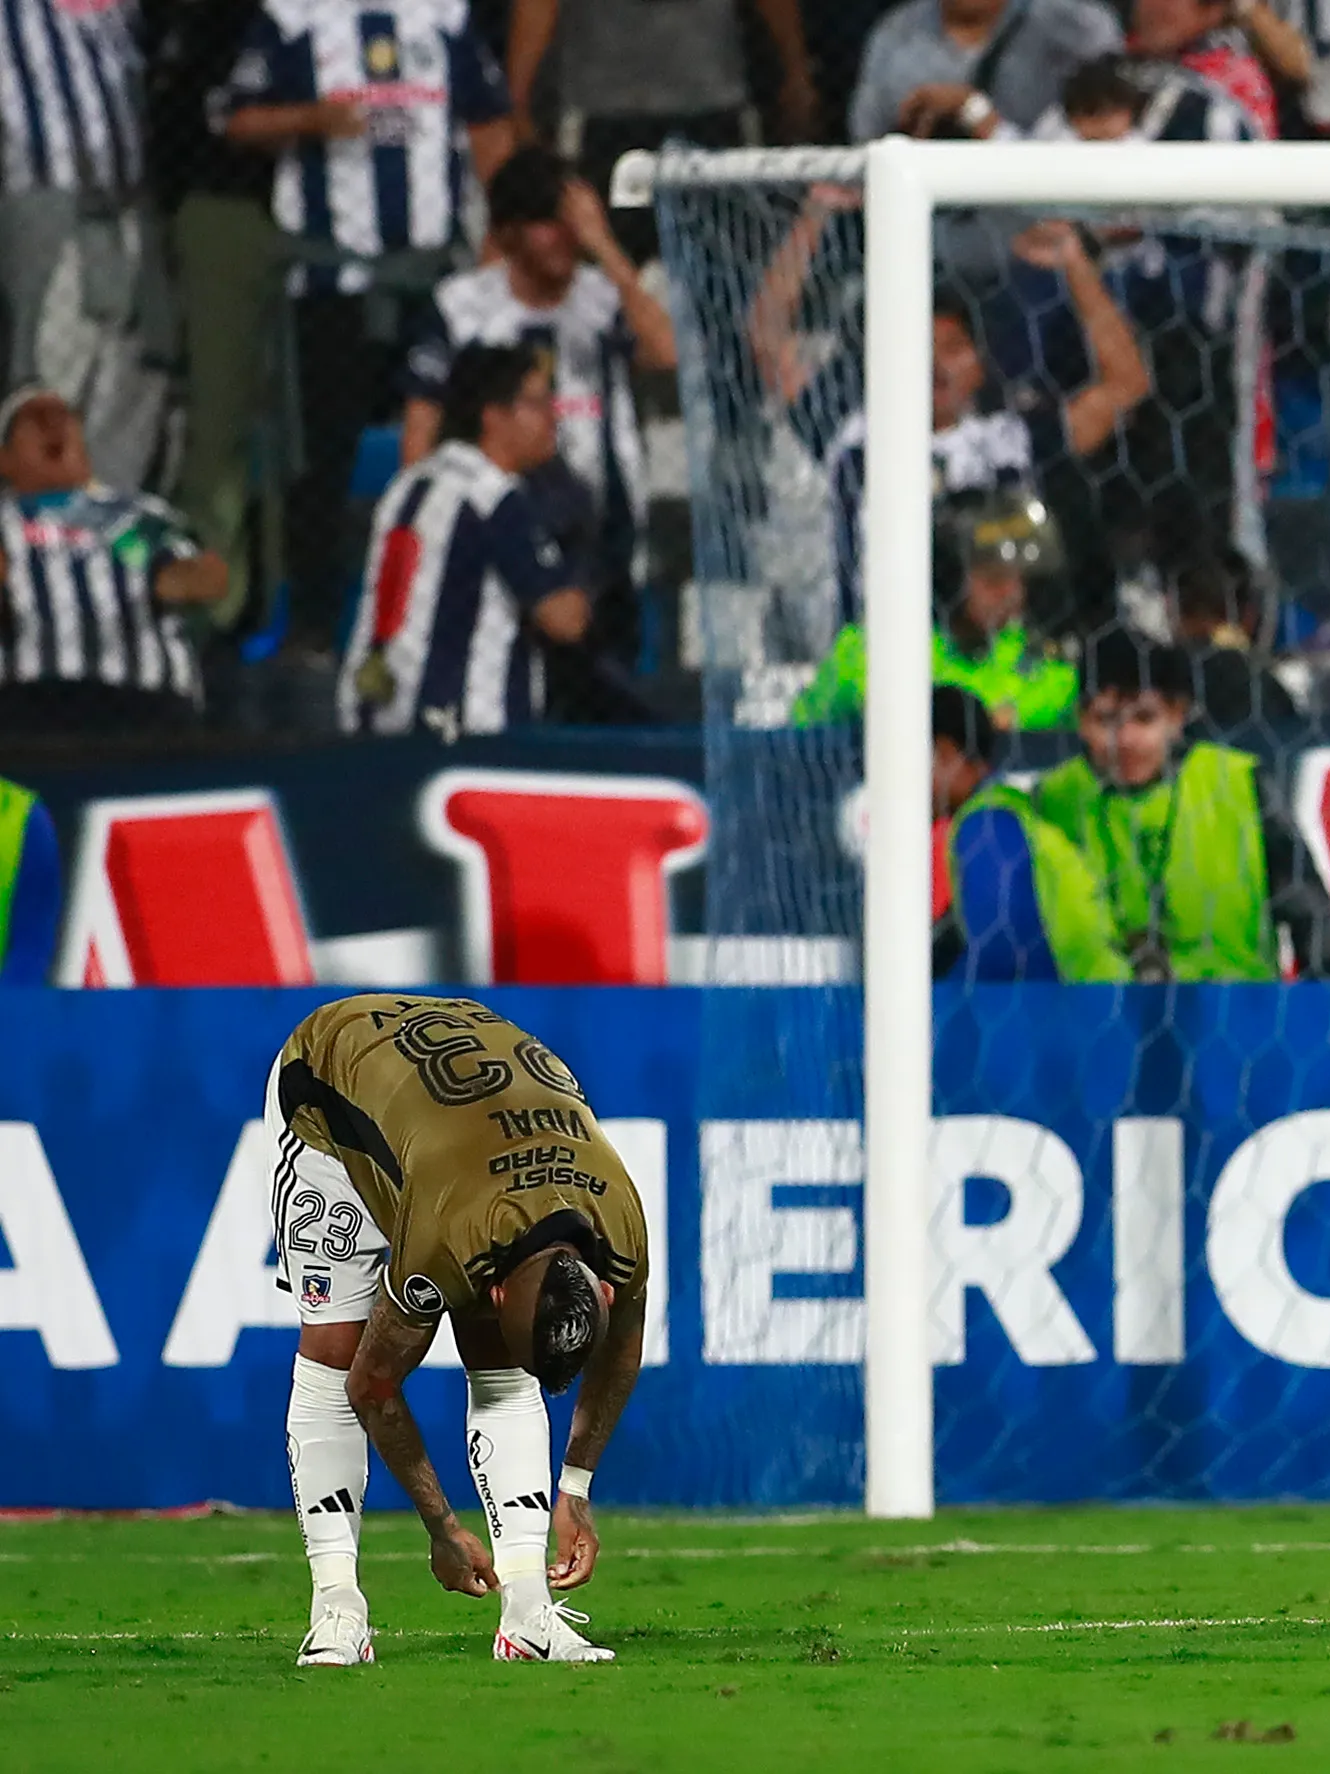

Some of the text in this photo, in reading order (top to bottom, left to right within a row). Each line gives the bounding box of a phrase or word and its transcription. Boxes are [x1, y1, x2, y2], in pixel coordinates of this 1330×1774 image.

[487, 1108, 591, 1142] VIDAL
[489, 1145, 576, 1175] CARD
[505, 1167, 608, 1196] ASSIST
[288, 1189, 363, 1263] 23
[477, 1472, 503, 1539] mercado
